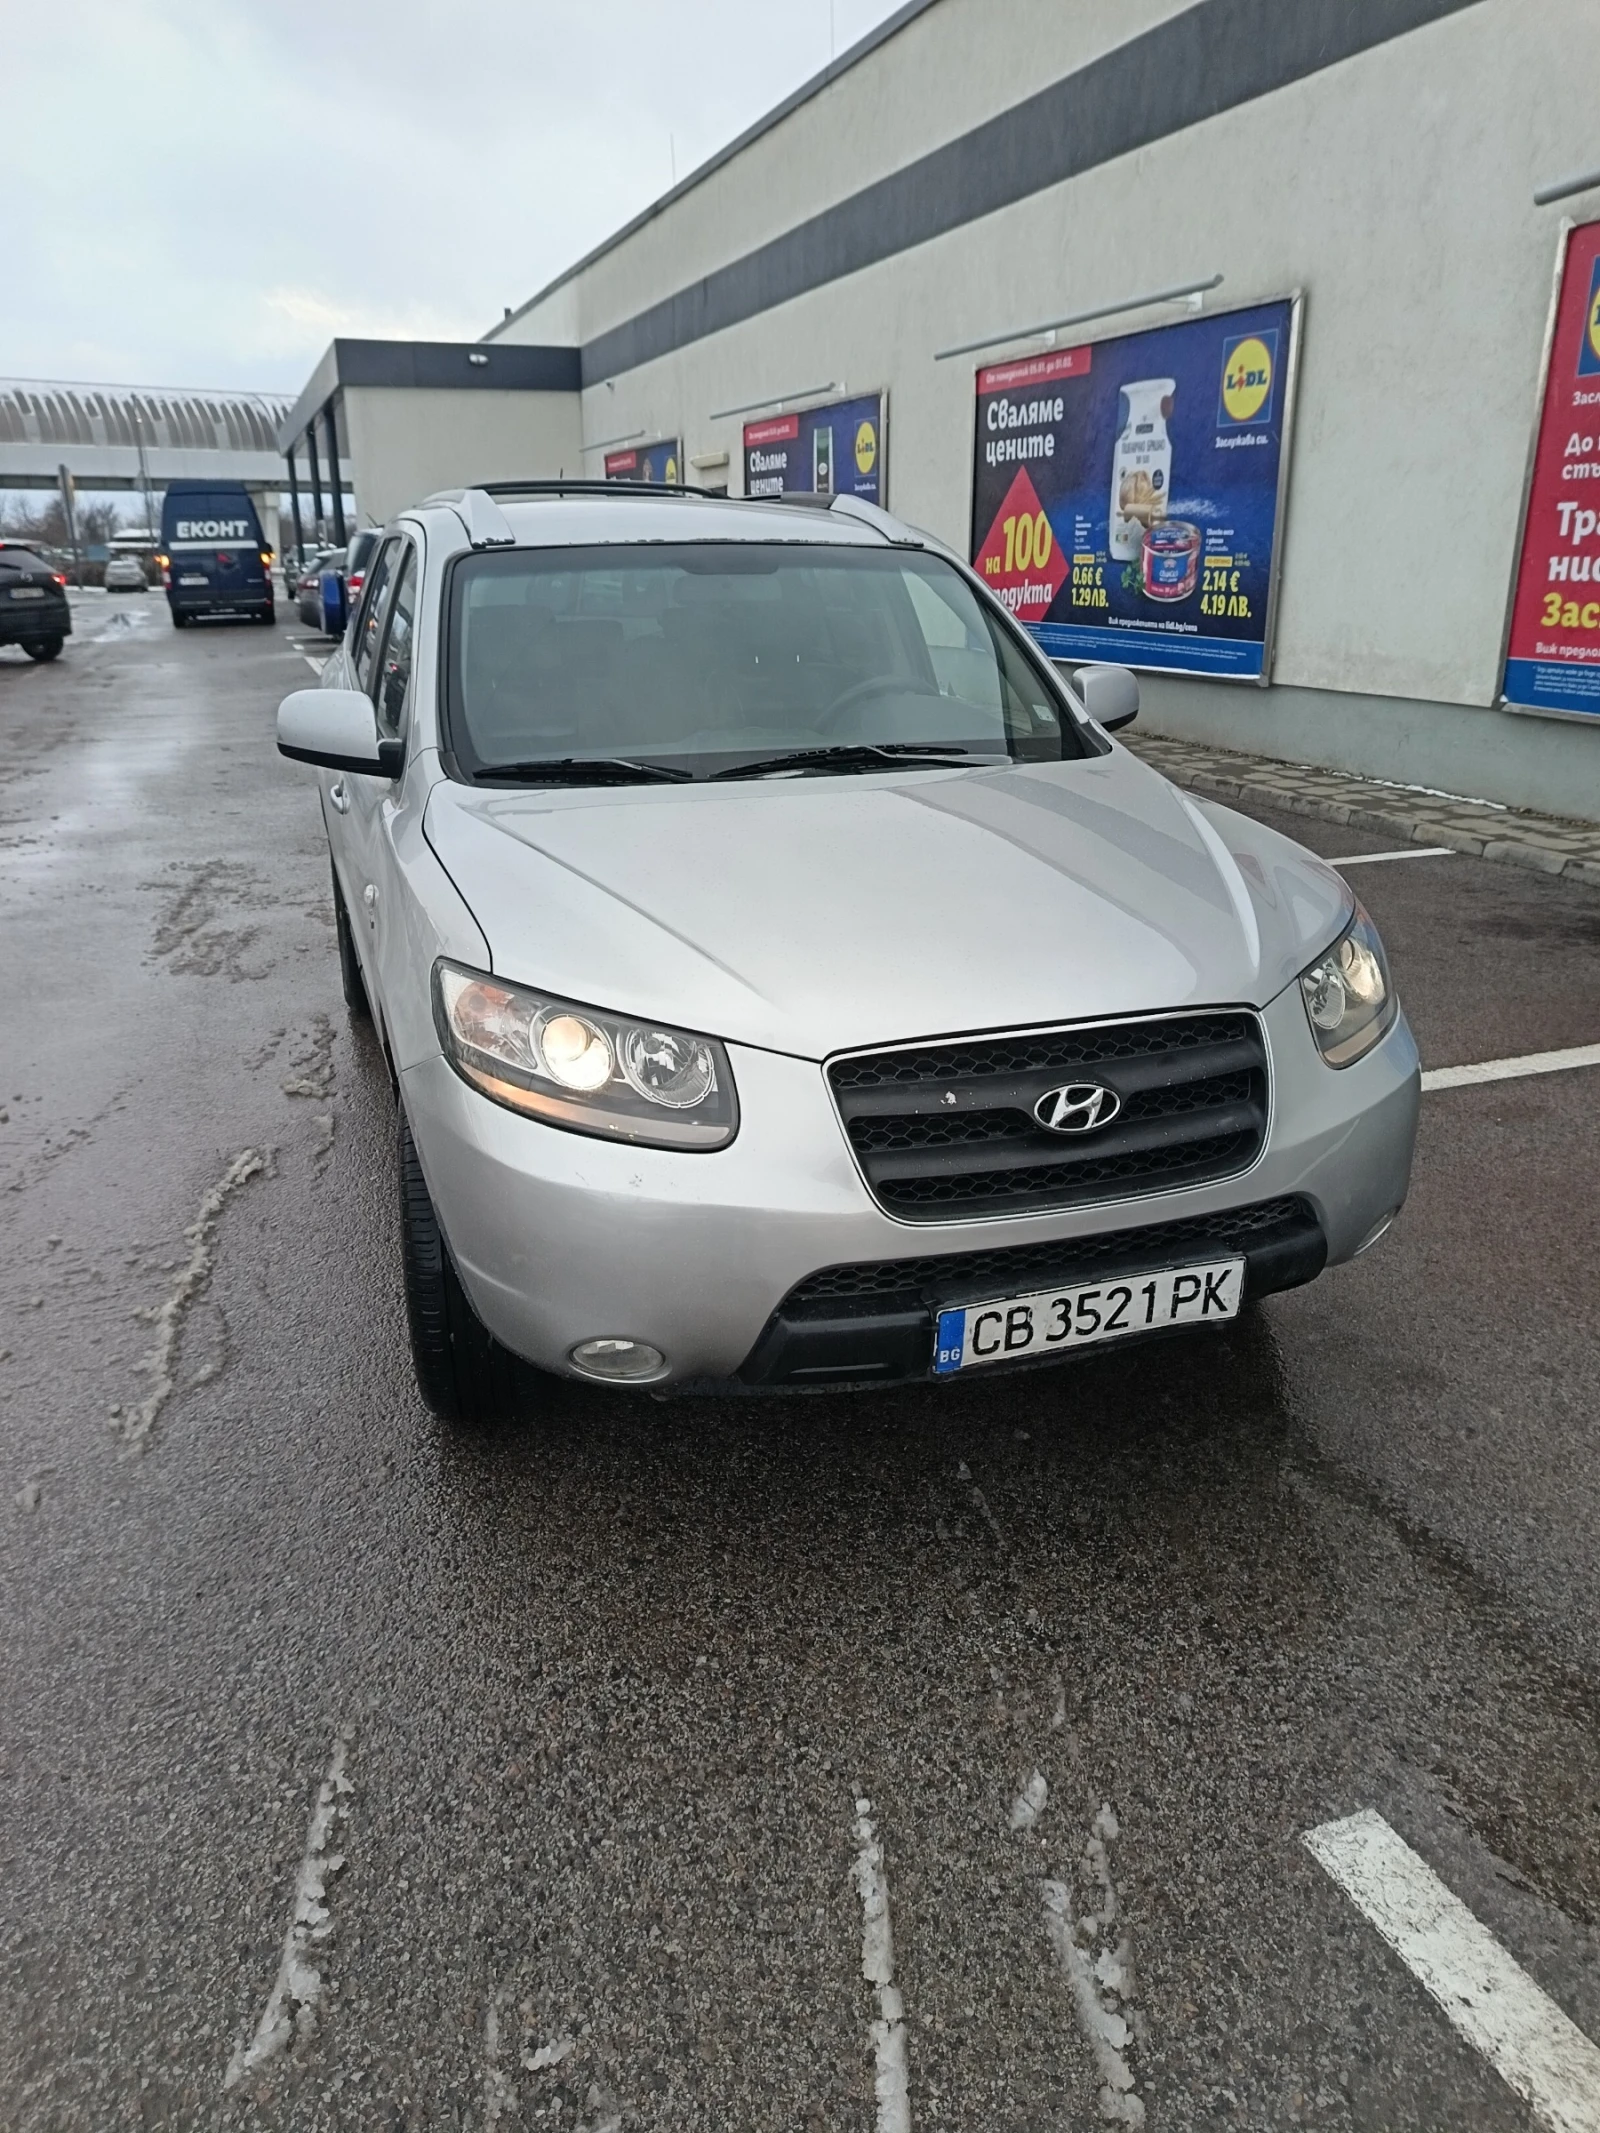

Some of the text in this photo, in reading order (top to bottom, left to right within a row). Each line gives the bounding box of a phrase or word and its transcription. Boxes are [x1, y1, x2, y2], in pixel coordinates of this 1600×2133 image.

[987, 397, 1064, 431] Сваляме
[986, 433, 1055, 467] цените
[1564, 432, 1594, 457] До
[750, 450, 787, 473] Сваляме
[1556, 501, 1600, 546] Тр
[985, 556, 1000, 575] на
[1003, 510, 1052, 572] 100
[1072, 566, 1103, 586] 0.66 €
[1202, 569, 1227, 592] 2.14
[1230, 570, 1241, 593] €
[1200, 593, 1226, 616] 4.19
[1540, 592, 1600, 629] Зас
[1535, 641, 1600, 660] Виж предло
[940, 1268, 1233, 1364] BG CB 3521 PK
